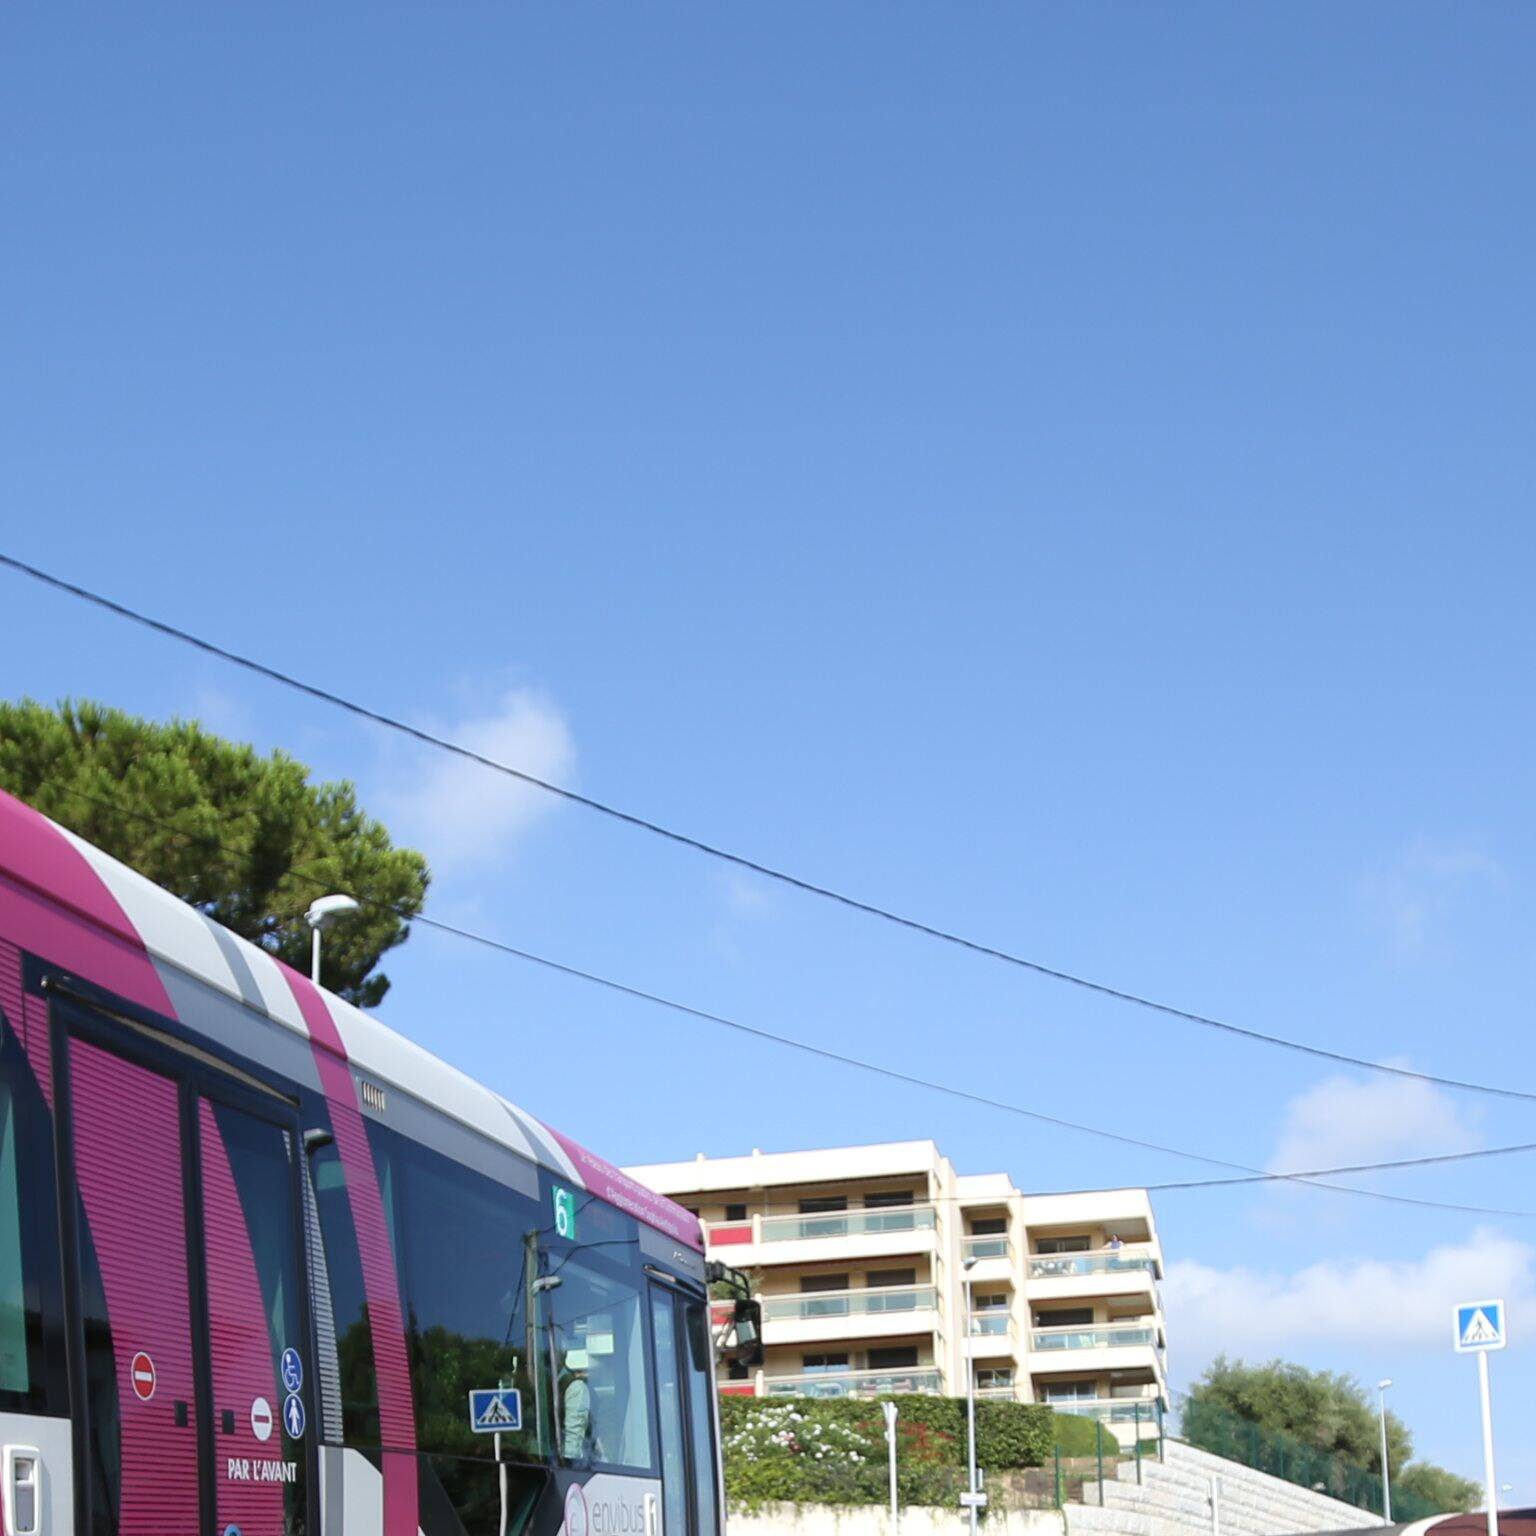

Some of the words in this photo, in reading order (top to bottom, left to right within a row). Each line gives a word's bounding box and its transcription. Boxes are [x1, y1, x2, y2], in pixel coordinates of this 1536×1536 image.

[555, 1188, 567, 1237] 6
[228, 1458, 249, 1480] PAR
[253, 1460, 297, 1482] L'AVANT
[592, 1495, 644, 1533] envibus
